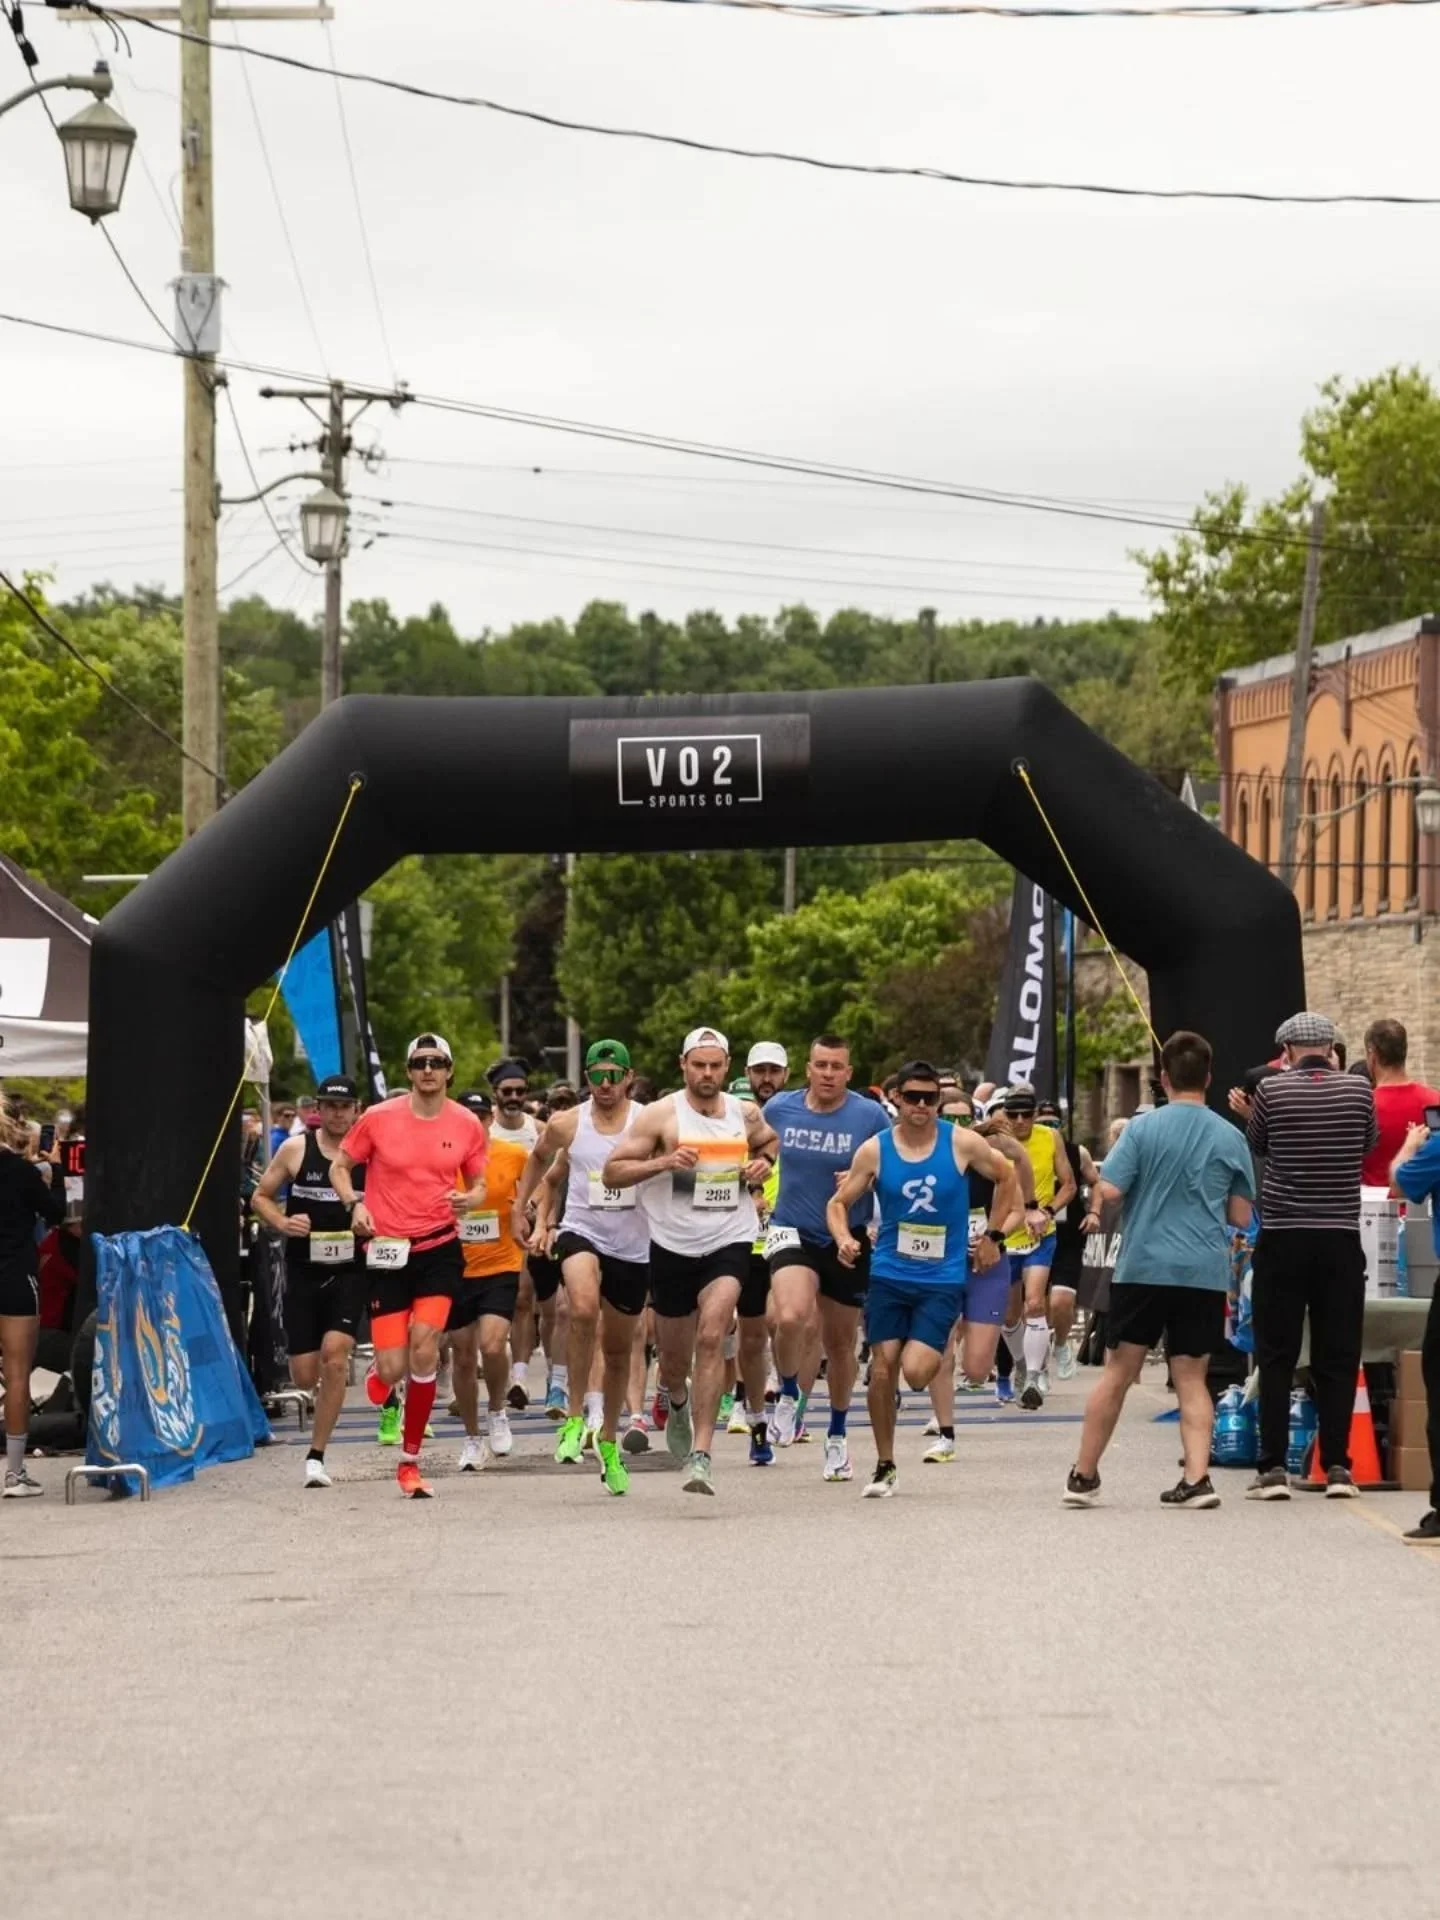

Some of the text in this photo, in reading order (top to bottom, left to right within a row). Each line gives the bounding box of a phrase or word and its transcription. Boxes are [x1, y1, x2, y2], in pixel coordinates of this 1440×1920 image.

[646, 745, 732, 787] VO2
[649, 793, 733, 808] SPORTS CO
[783, 1127, 853, 1154] OCEAN
[603, 1188, 621, 1201] 29
[705, 1188, 731, 1201] 288
[465, 1223, 490, 1236] 290
[324, 1246, 339, 1256] 21
[911, 1239, 930, 1251] 59
